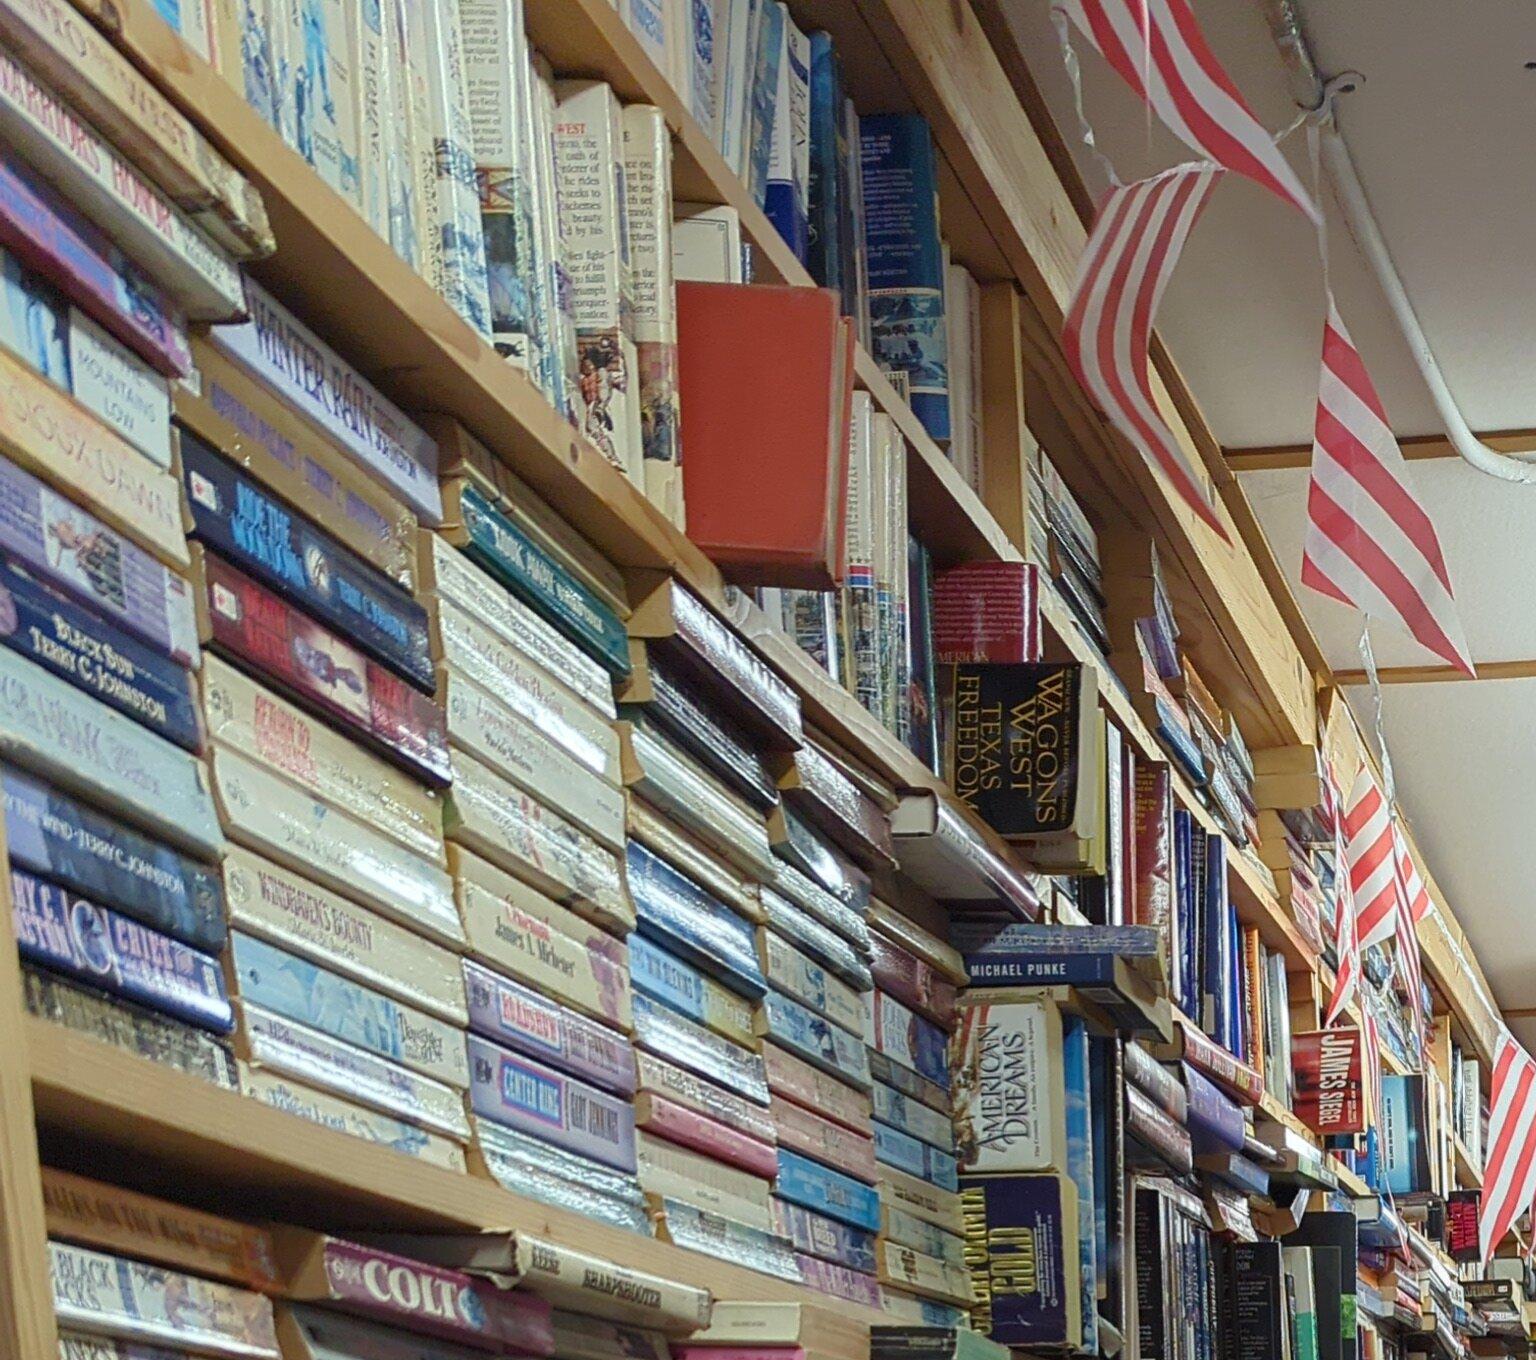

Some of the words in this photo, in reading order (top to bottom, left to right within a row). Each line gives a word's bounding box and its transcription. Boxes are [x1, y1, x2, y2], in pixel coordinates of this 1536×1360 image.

[957, 676, 980, 811] FREEDOM
[980, 701, 1002, 790] TEXAS
[1010, 696, 1037, 797] WEST
[1035, 670, 1065, 823] WAGONS
[970, 965, 1023, 977] MICHAEL
[1027, 963, 1067, 975] PUNKE
[976, 1025, 1004, 1153] AMERICAN
[1001, 1031, 1031, 1147] DREAMS
[1320, 1034, 1354, 1090] JAMES
[1319, 1091, 1344, 1126] SIEGEL
[363, 1260, 458, 1322] COLT
[988, 1227, 1036, 1296] GOLD
